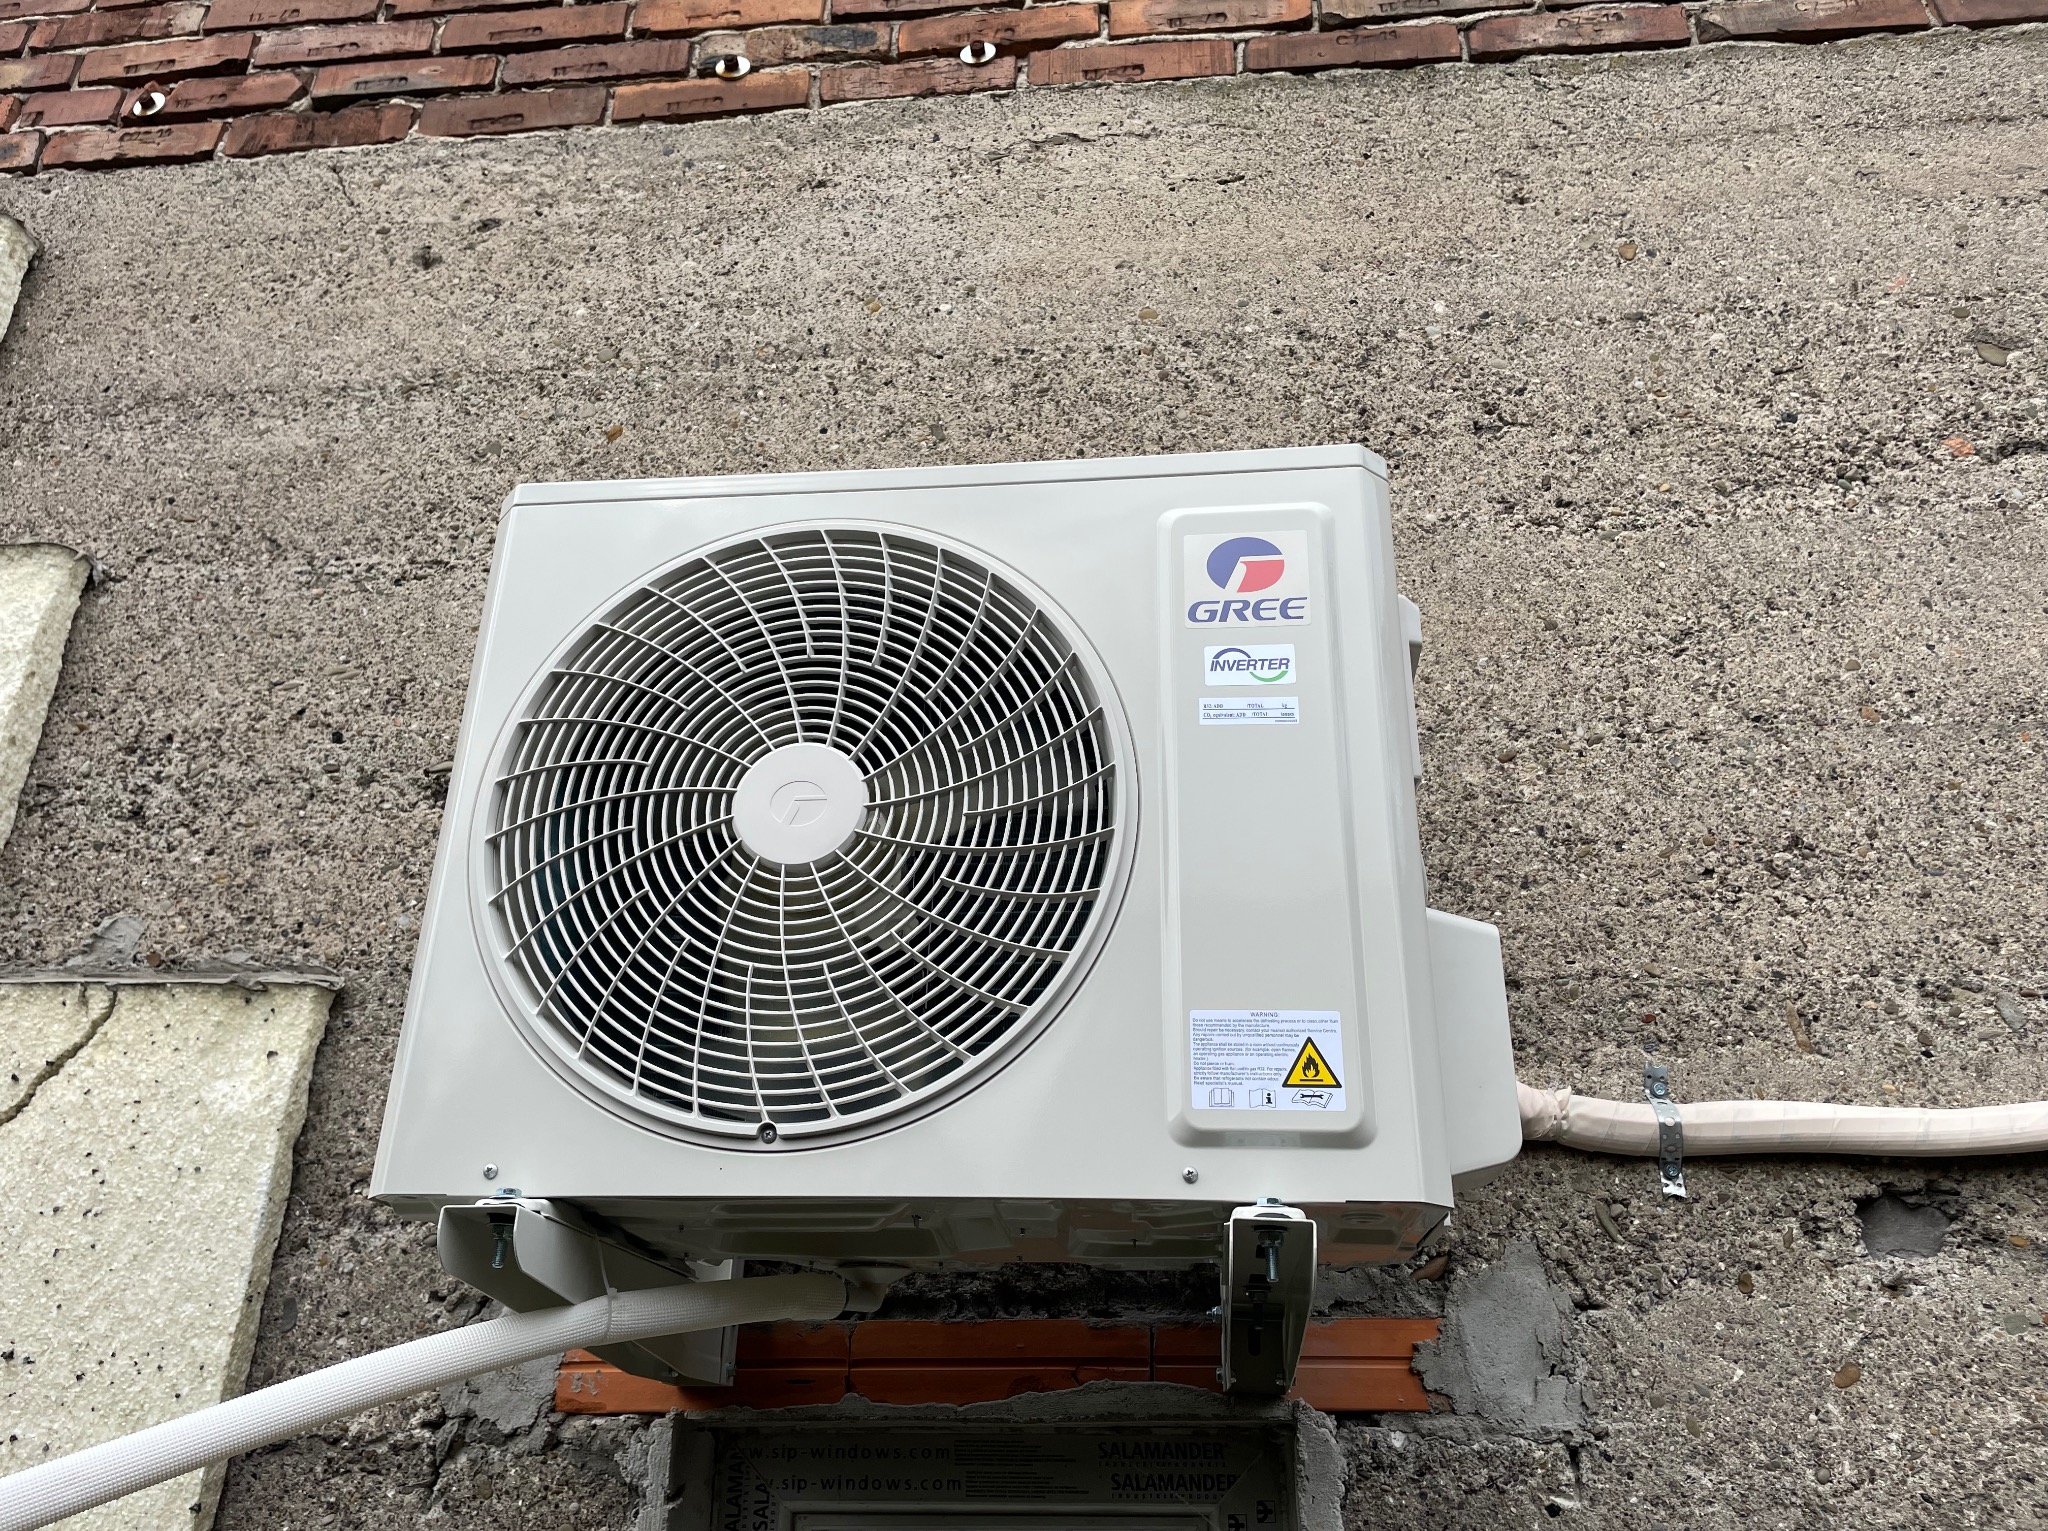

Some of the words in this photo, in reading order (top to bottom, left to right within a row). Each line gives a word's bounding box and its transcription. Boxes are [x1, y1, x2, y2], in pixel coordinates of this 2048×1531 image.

[1188, 596, 1308, 623] GREE
[1210, 658, 1290, 671] INVERTER
[743, 1443, 951, 1463] w.sip-windows.com
[1097, 1441, 1226, 1460] SALAMANDER
[753, 1475, 771, 1531] SALA
